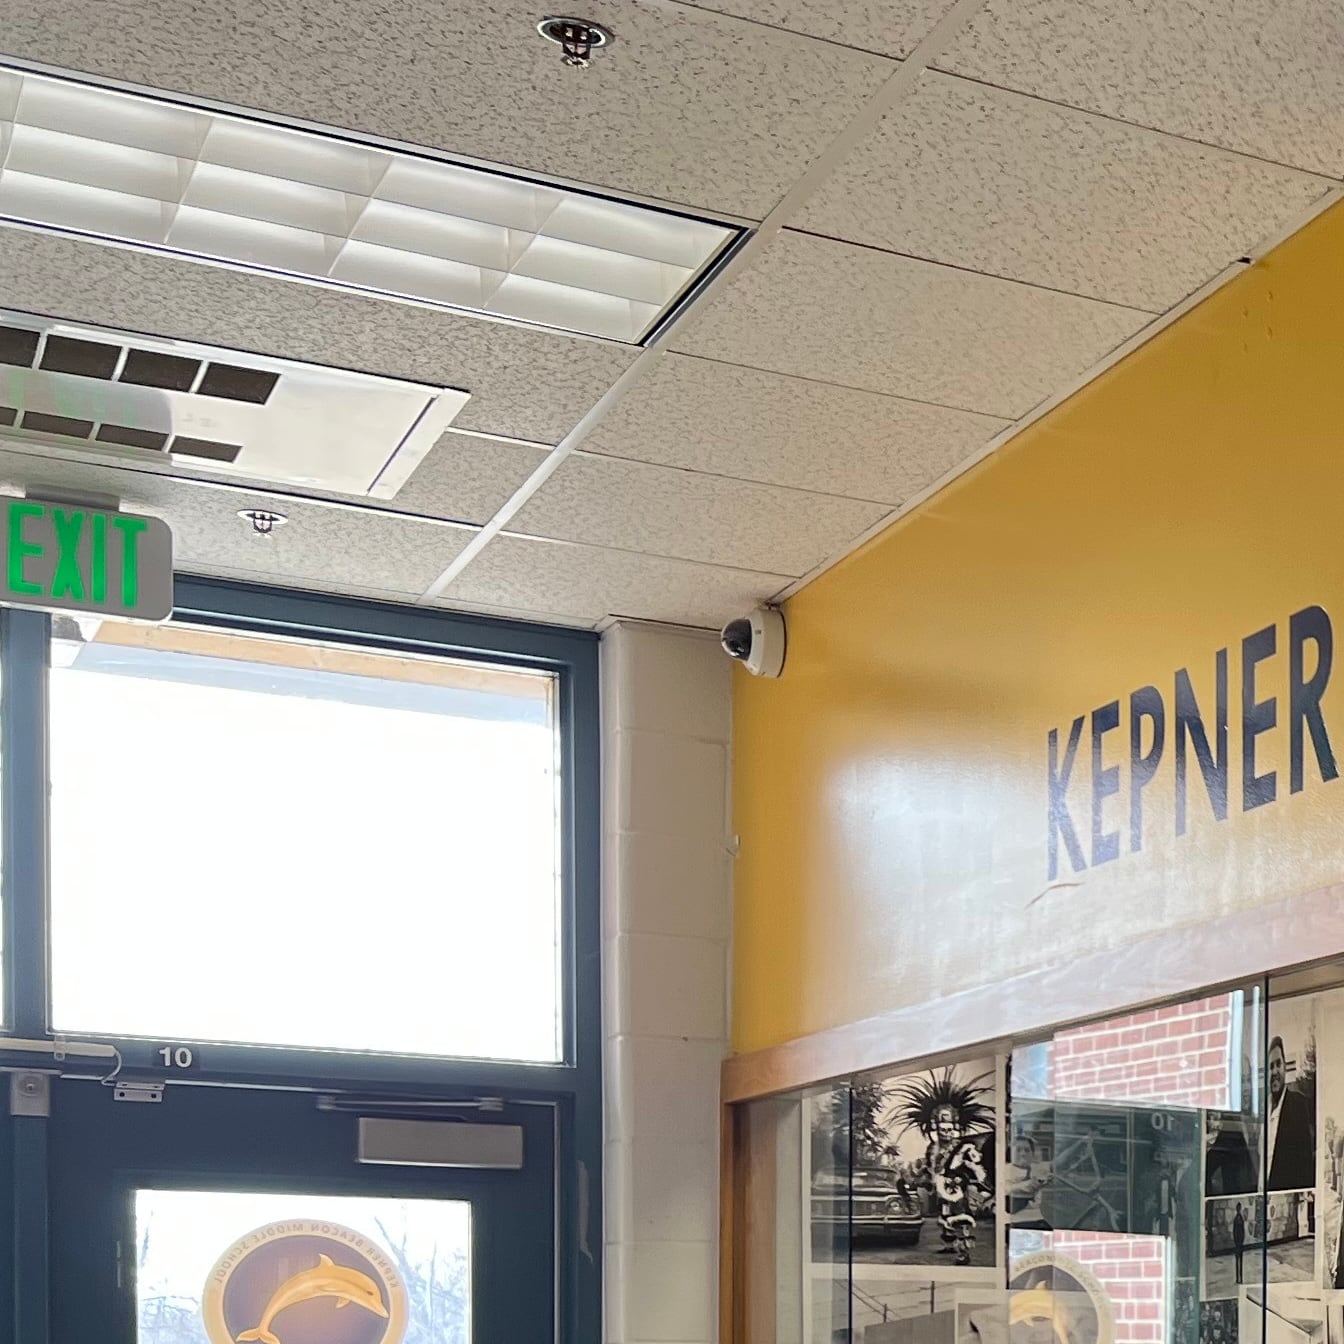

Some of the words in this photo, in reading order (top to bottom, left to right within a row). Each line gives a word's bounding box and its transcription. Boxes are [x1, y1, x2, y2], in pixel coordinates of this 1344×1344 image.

[8, 502, 148, 608] EXIT
[1046, 605, 1338, 880] KEPNER
[159, 1046, 192, 1068] 10
